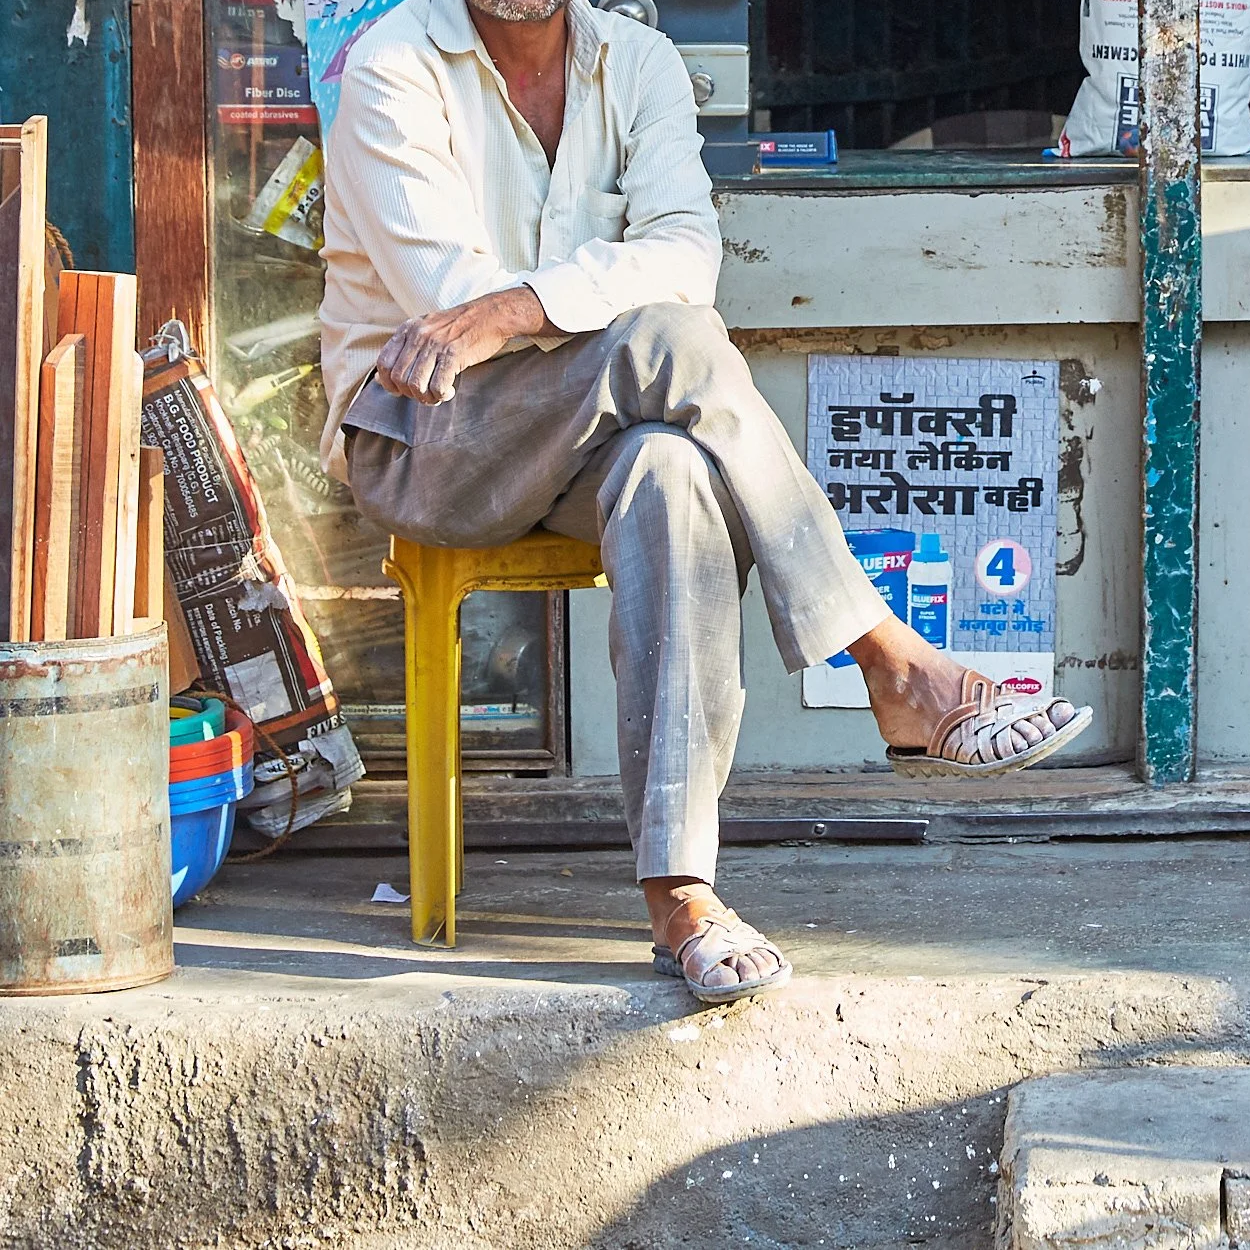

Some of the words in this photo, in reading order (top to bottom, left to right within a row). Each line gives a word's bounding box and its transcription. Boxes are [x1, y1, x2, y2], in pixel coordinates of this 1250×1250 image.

[1205, 1, 1224, 9] MOST
[1092, 43, 1138, 62] CEMENT
[1221, 51, 1250, 69] WHITE
[245, 87, 273, 99] Fiber
[276, 87, 300, 99] Disc
[230, 111, 257, 119] coated
[259, 111, 299, 119] abrasives
[143, 402, 167, 440] Customer
[828, 392, 1017, 442] इपॉक्सी
[162, 393, 181, 418] B.G.
[174, 416, 197, 449] FOOD
[189, 448, 218, 504] PRODUCT
[827, 448, 896, 470] नया
[907, 441, 1012, 472] लेकिन
[200, 445, 218, 475] Packed
[827, 472, 979, 516] भरोसा
[983, 477, 1043, 512] वही
[860, 553, 908, 571] LUEFIX
[986, 547, 1016, 586] 4
[913, 594, 945, 604] BLUEFIX
[204, 602, 216, 621] Date
[231, 617, 243, 633] No.
[307, 714, 339, 739] FIVE
